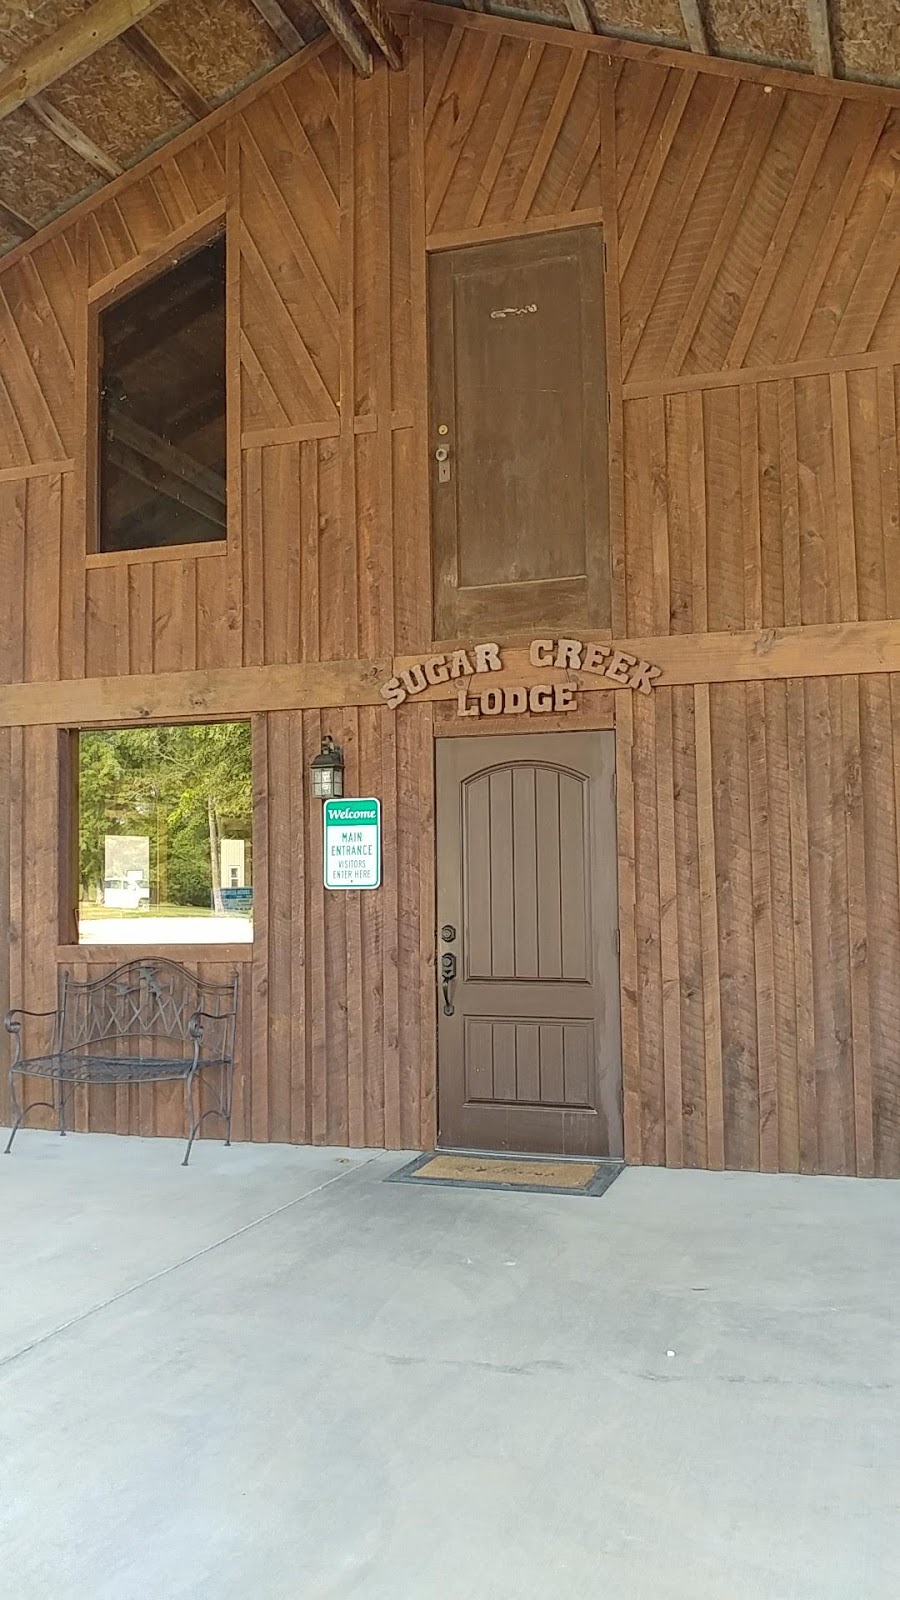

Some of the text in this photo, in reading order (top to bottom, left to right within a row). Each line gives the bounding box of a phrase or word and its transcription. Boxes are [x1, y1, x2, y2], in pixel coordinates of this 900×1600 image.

[380, 639, 662, 710] SUGAR CREEK
[457, 682, 579, 717] LODGE
[328, 807, 377, 820] Welcome
[342, 832, 363, 843] MAIN
[331, 844, 373, 856] ENTRANCE
[338, 859, 366, 869] VISITORS
[332, 869, 371, 879] ENTER HERE
